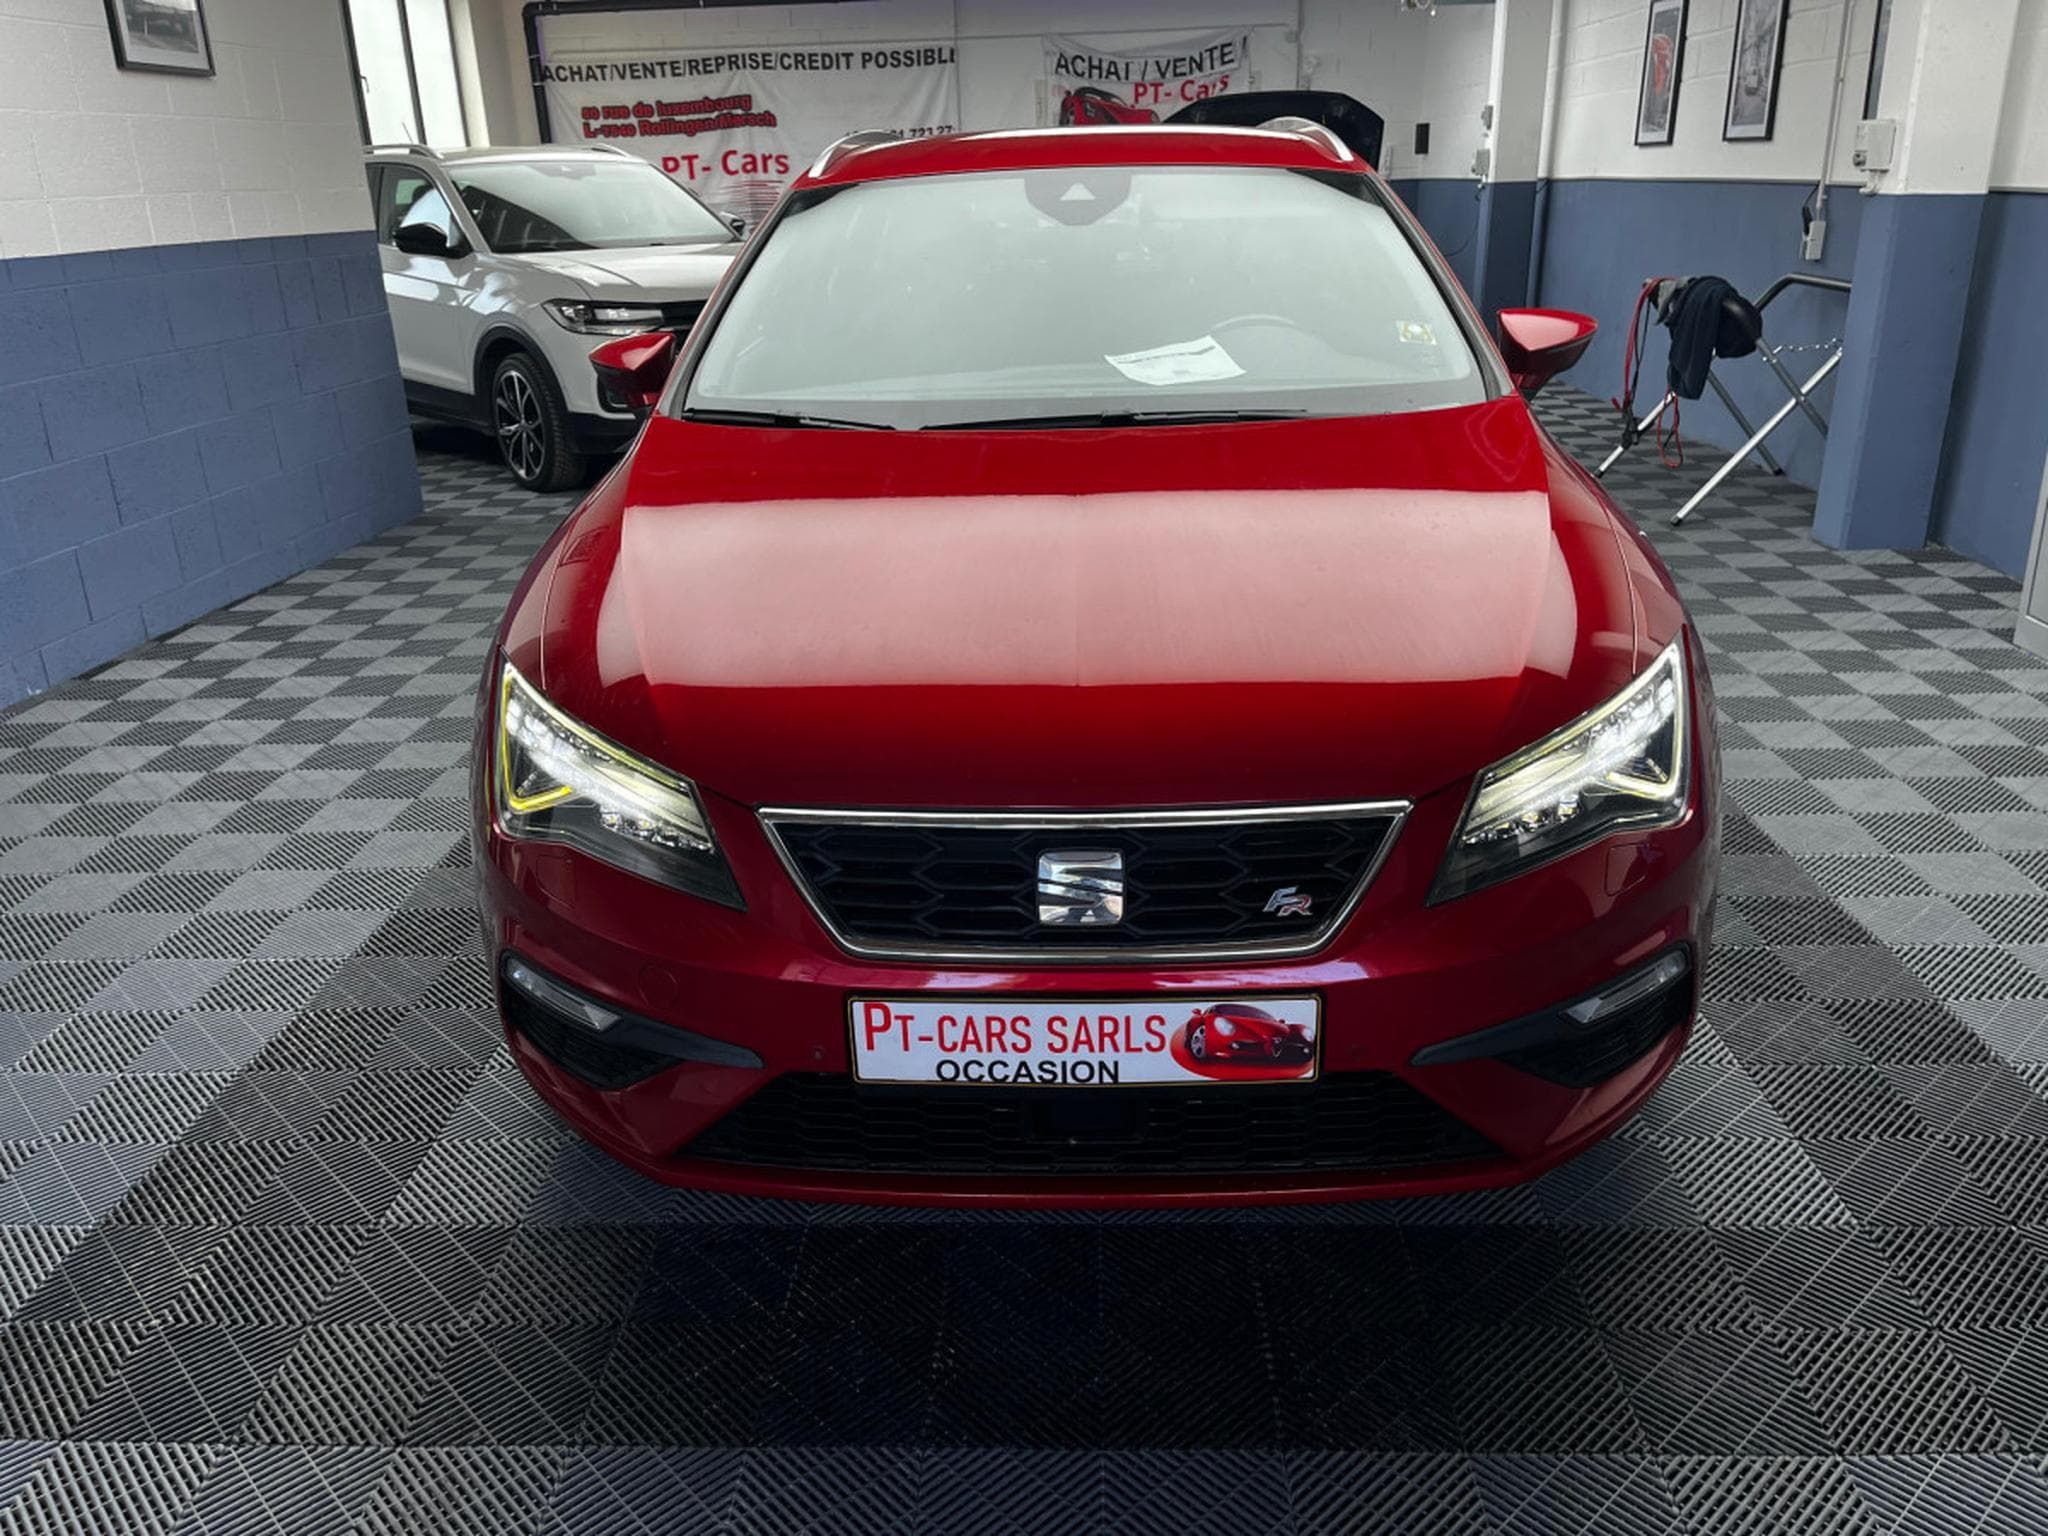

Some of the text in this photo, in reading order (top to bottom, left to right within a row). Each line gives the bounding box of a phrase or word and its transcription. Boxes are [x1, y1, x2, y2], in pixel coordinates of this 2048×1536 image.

[1155, 42, 1235, 79] VENTE
[632, 101, 655, 119] de
[721, 149, 790, 176] Cars
[1046, 1015, 1167, 1054] SARLS
[936, 1059, 1120, 1084] OCCASION
